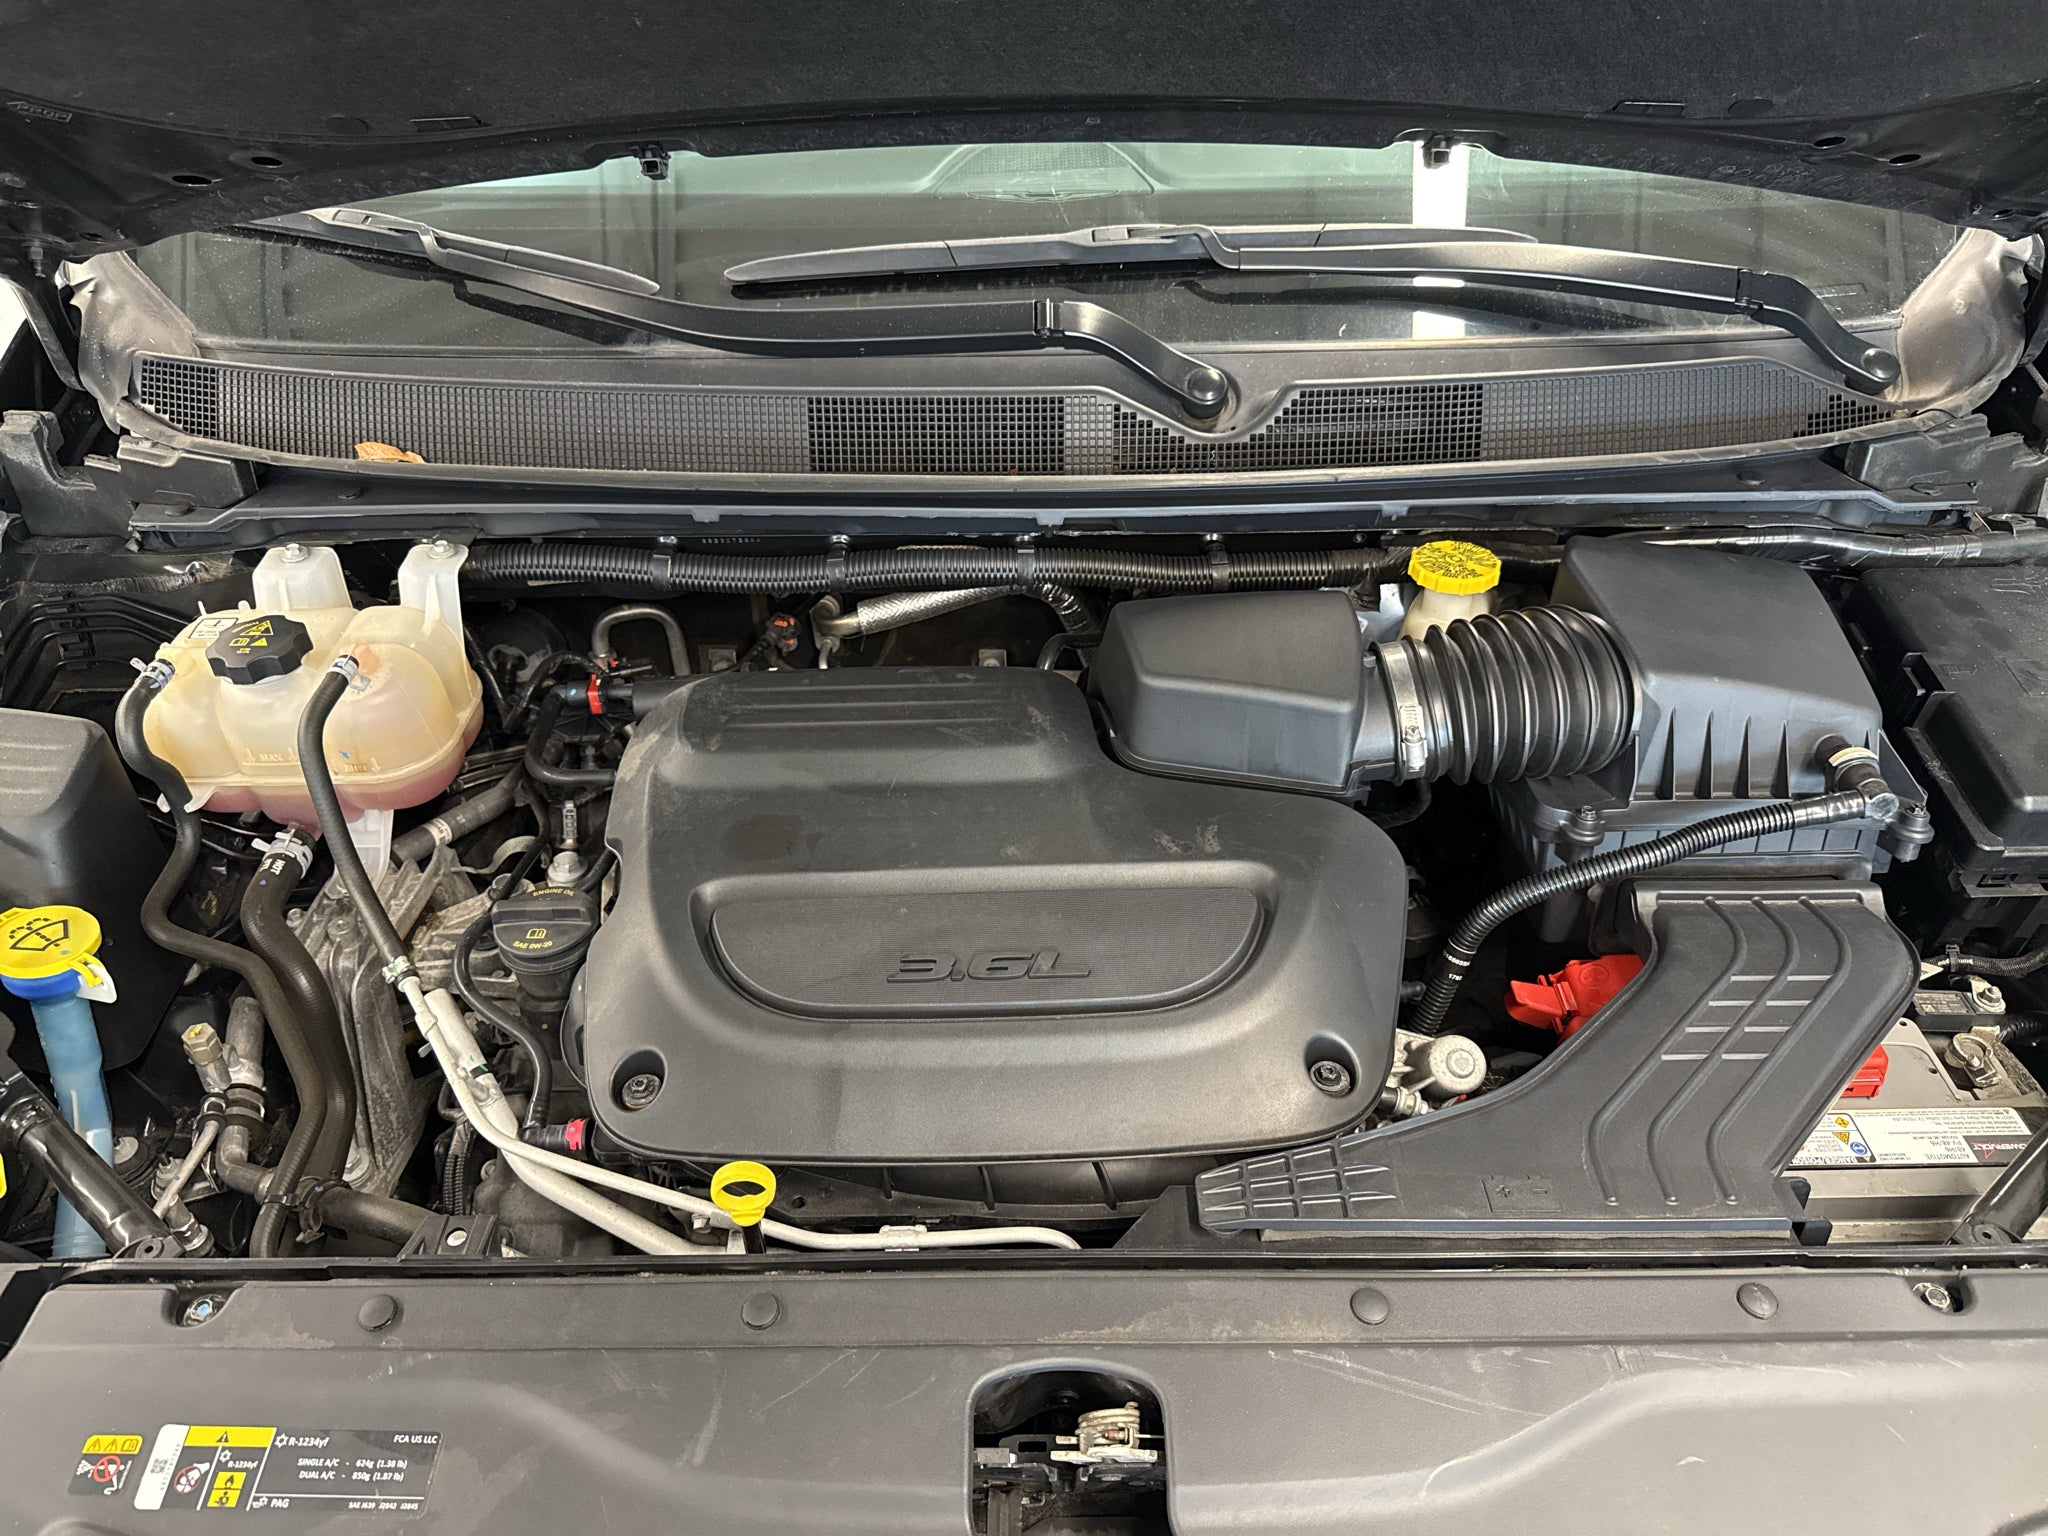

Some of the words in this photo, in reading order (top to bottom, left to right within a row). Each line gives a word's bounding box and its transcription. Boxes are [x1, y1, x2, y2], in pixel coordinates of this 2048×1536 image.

[270, 859, 286, 875] HOT
[533, 888, 562, 896] ENGINE
[513, 941, 529, 949] SAE
[529, 941, 553, 949] 0W-20
[887, 950, 1091, 984] 3.6L
[1972, 1143, 2028, 1151] OWERVOLT
[288, 1436, 330, 1448] R-1234yf
[393, 1435, 410, 1444] FCA
[411, 1435, 423, 1444] US
[424, 1435, 438, 1444] LLC
[297, 1458, 324, 1467] SINGLE
[325, 1458, 340, 1468] A/C
[356, 1460, 375, 1469] 624g
[377, 1460, 396, 1469] (1.38
[397, 1460, 408, 1469] lb)
[299, 1471, 319, 1479] DUAL
[320, 1471, 336, 1480] A/C
[352, 1472, 370, 1481] 850g
[373, 1472, 393, 1481] (1.87
[393, 1473, 405, 1481] lb)
[270, 1499, 289, 1508] PAG
[348, 1501, 361, 1509] SAE
